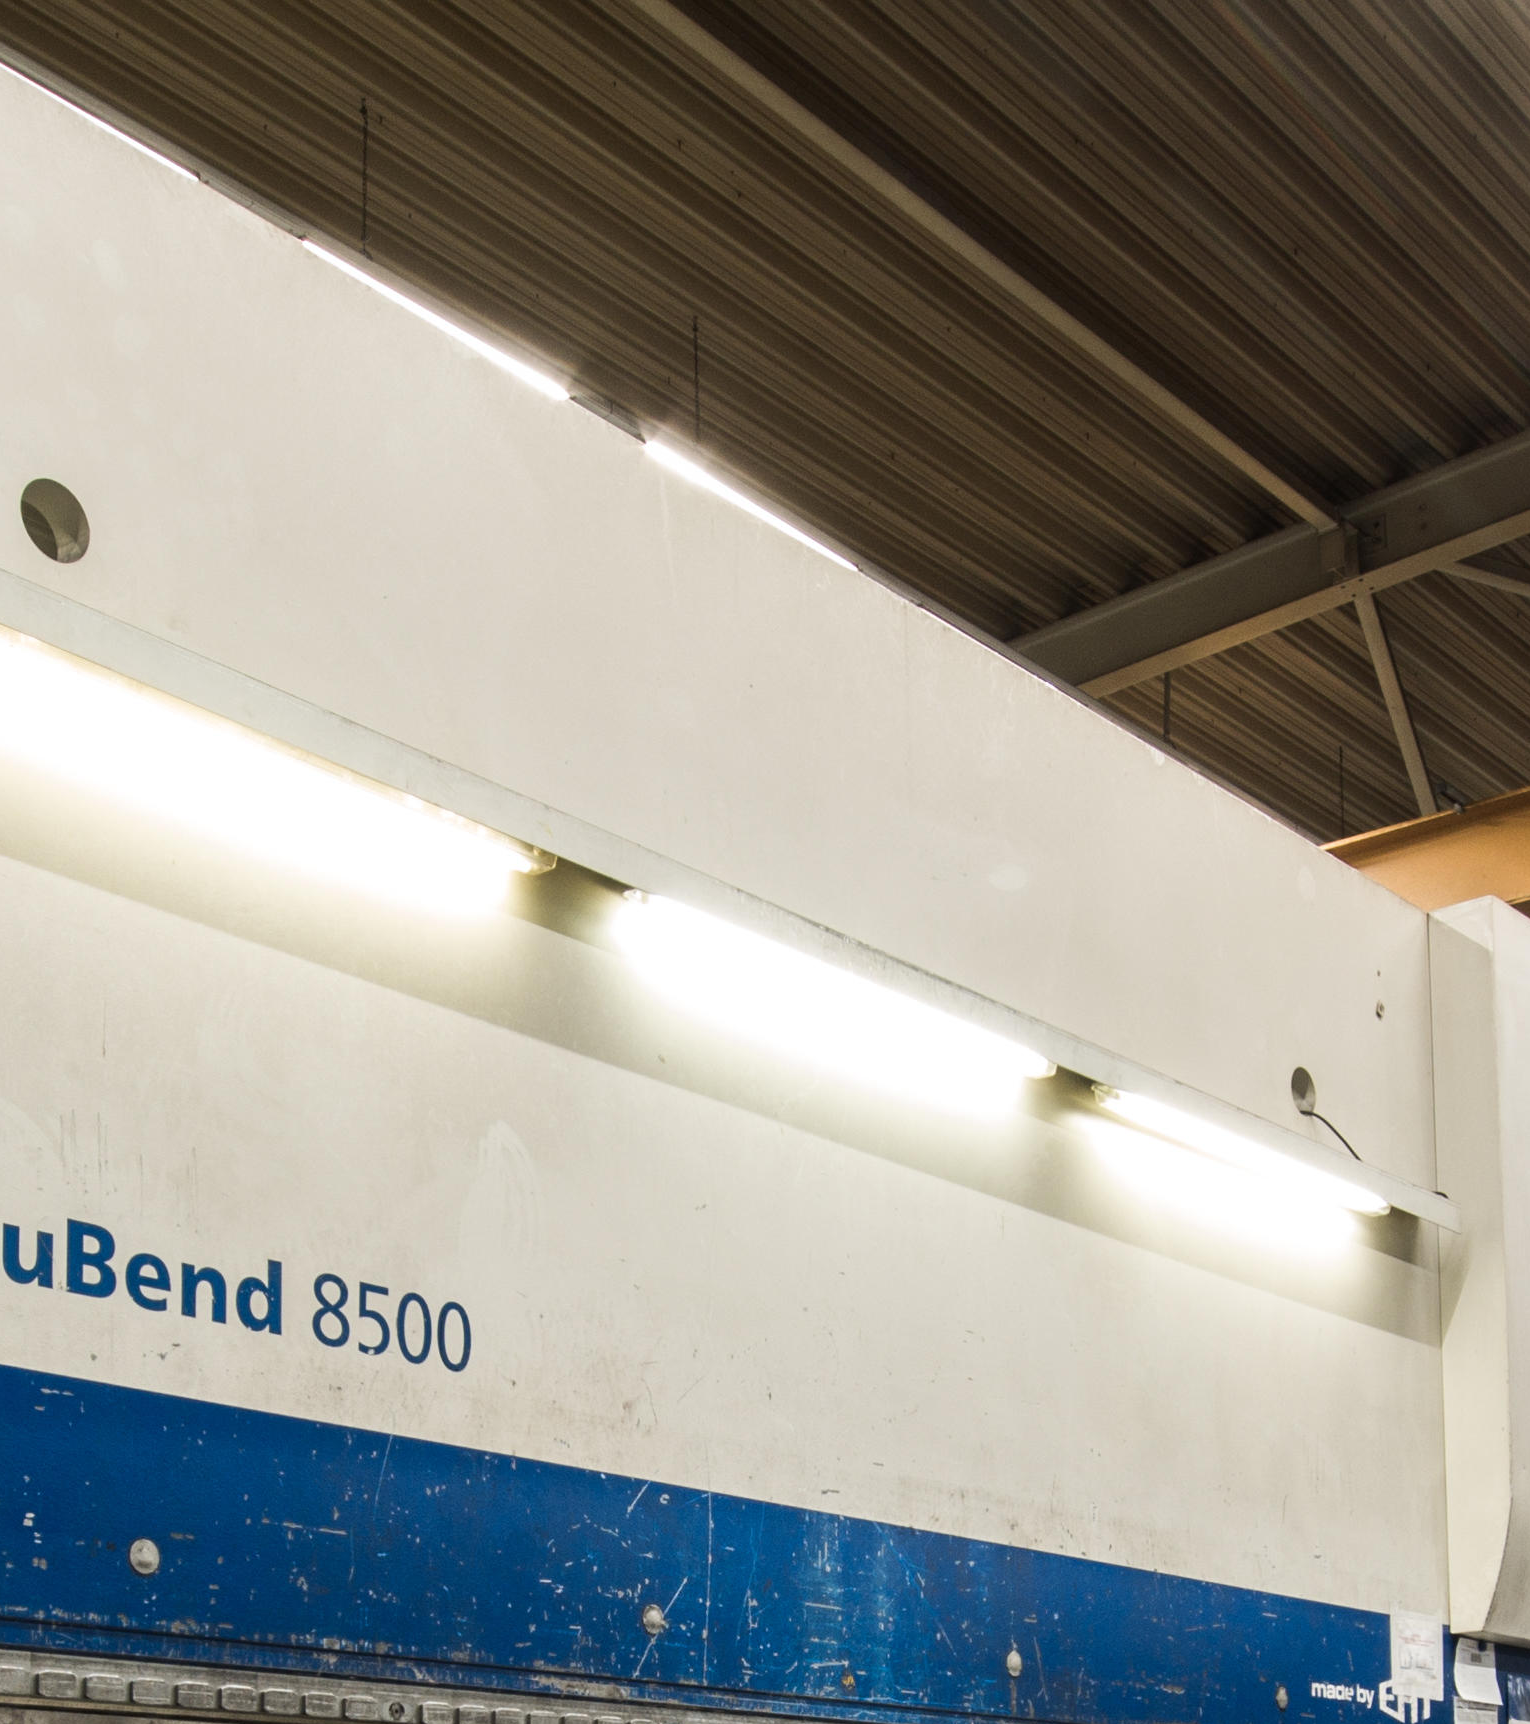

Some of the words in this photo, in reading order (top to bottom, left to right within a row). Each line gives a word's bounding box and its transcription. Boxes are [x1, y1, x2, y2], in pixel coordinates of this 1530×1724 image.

[311, 1273, 471, 1373] 8500
[1311, 1682, 1354, 1701] made
[1356, 1683, 1374, 1709] by
